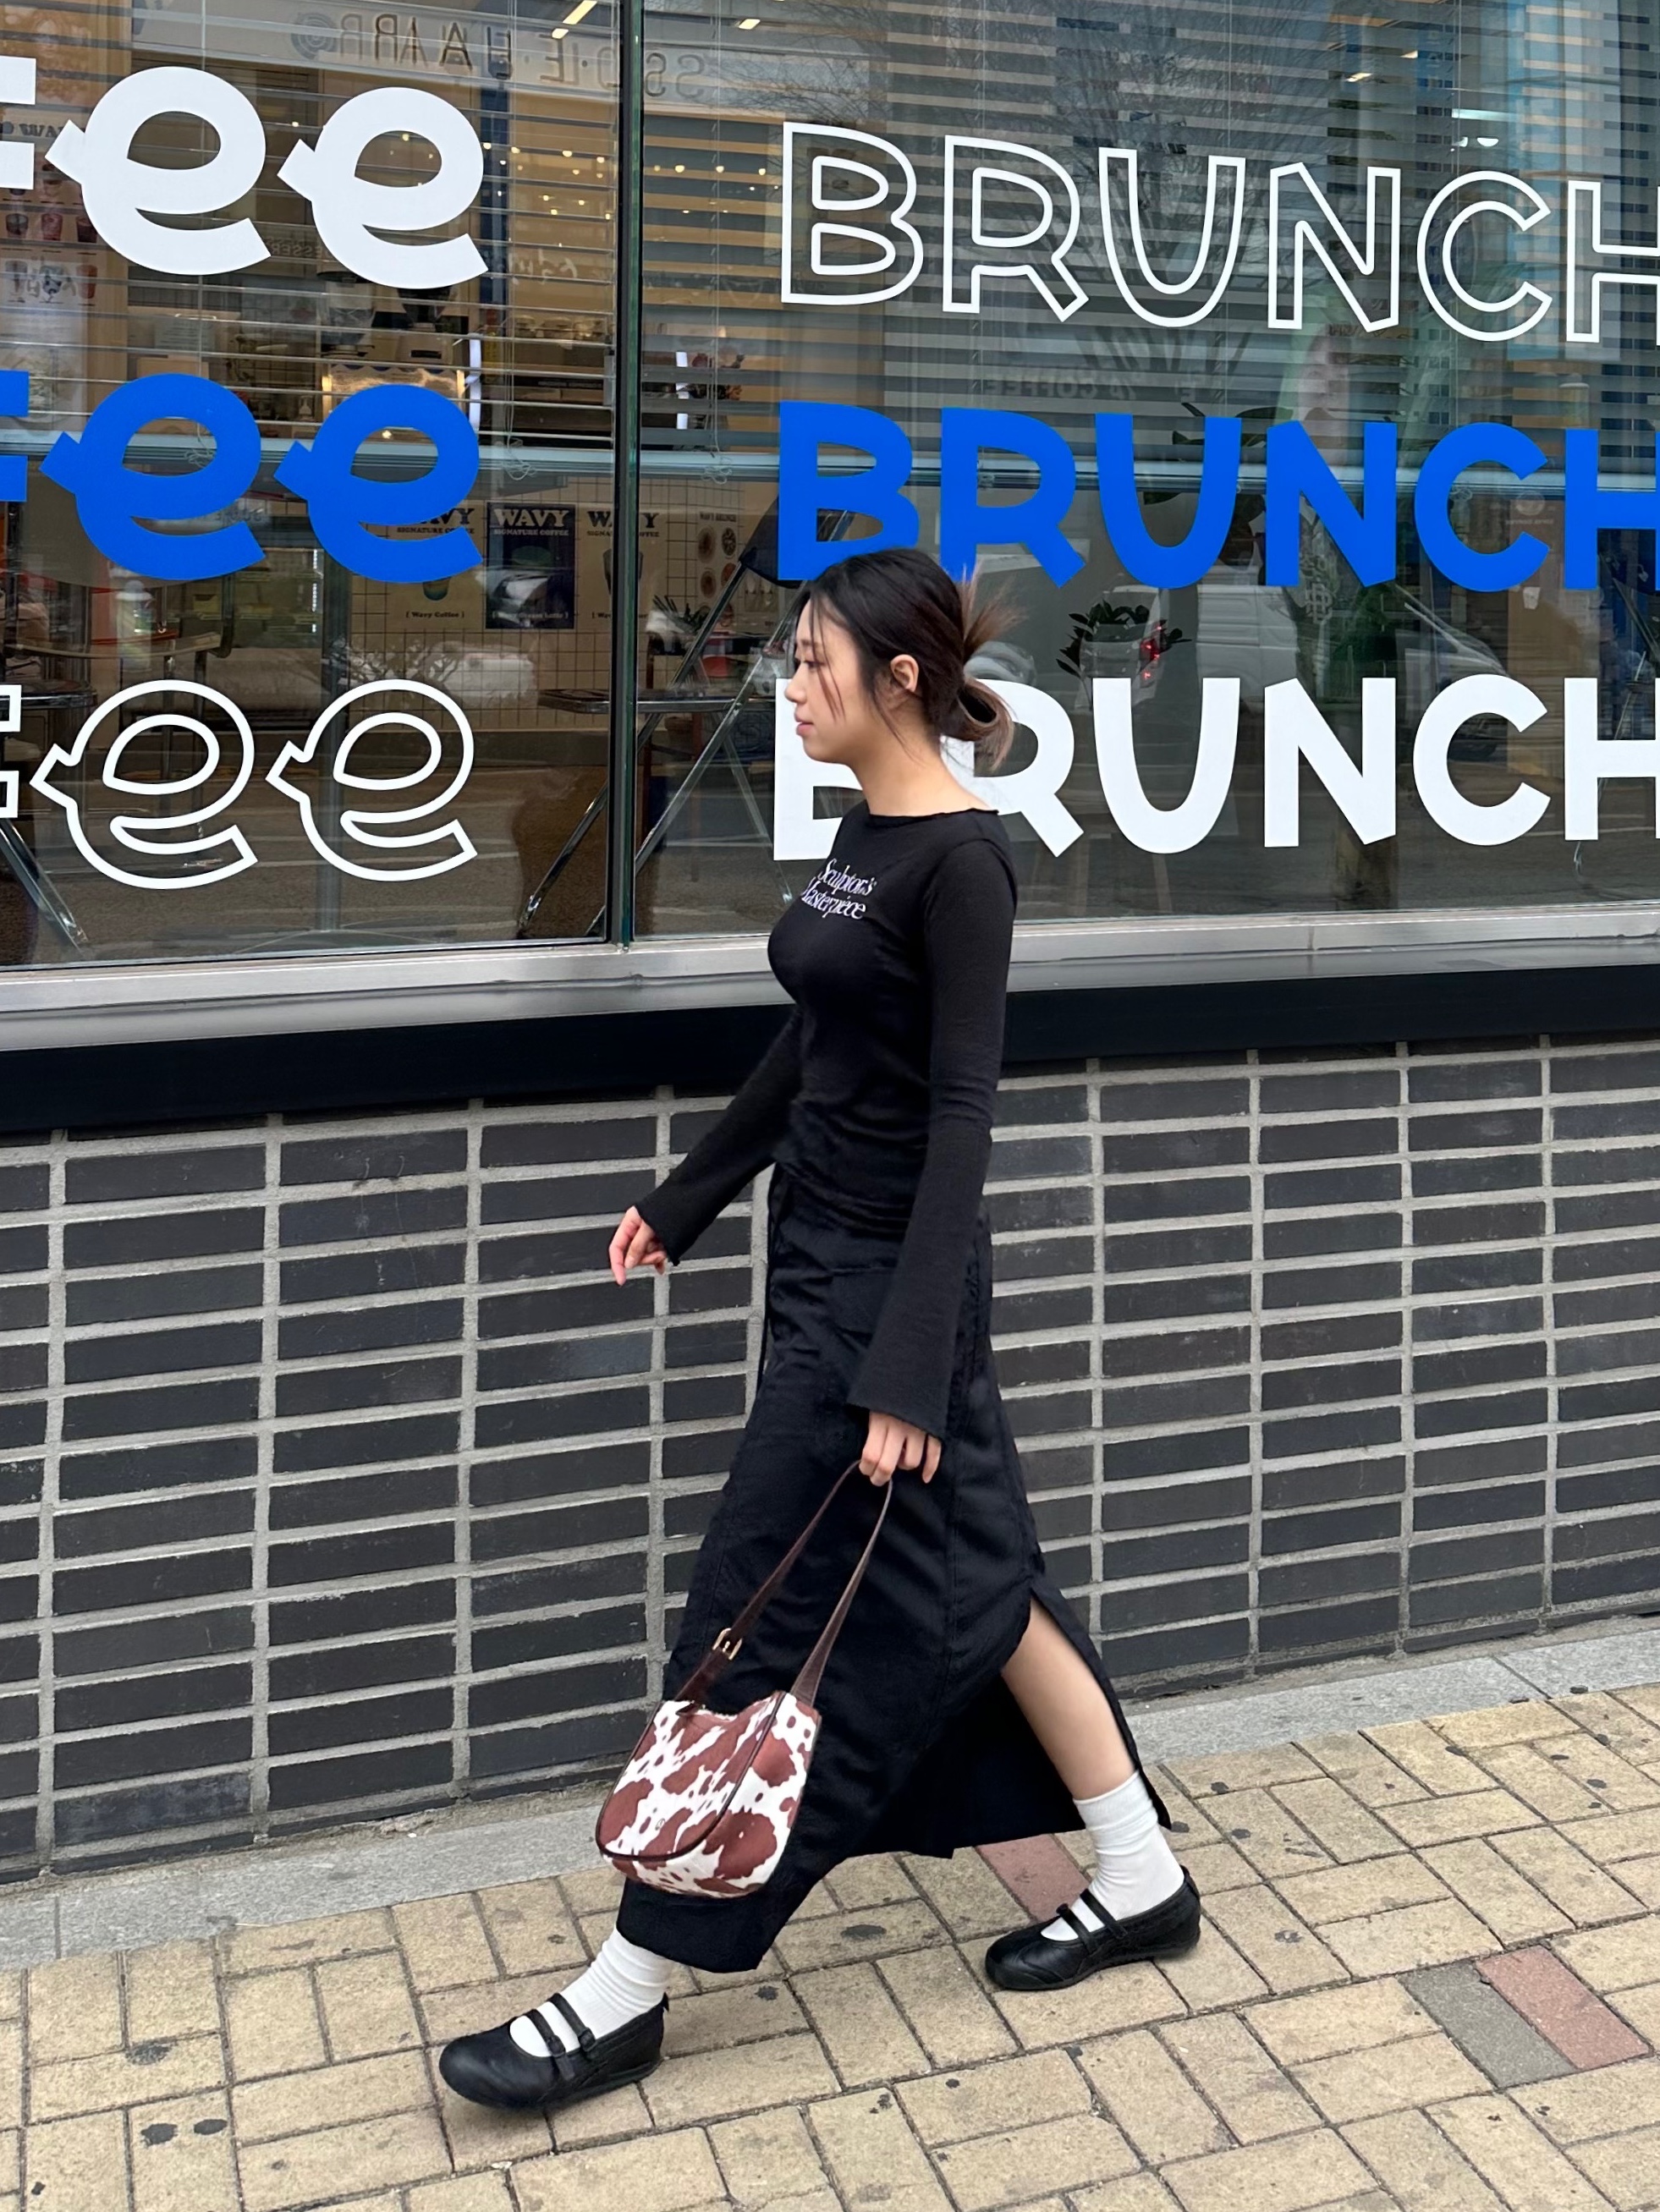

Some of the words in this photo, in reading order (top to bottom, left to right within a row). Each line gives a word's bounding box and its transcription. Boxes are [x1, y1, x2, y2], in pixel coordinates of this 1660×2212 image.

[0, 56, 487, 288] ee
[782, 123, 1660, 345] BRUNCH
[0, 371, 481, 581] ee
[493, 508, 569, 527] WAVY
[779, 402, 1660, 590] BRUNCH
[0, 679, 477, 889] ee
